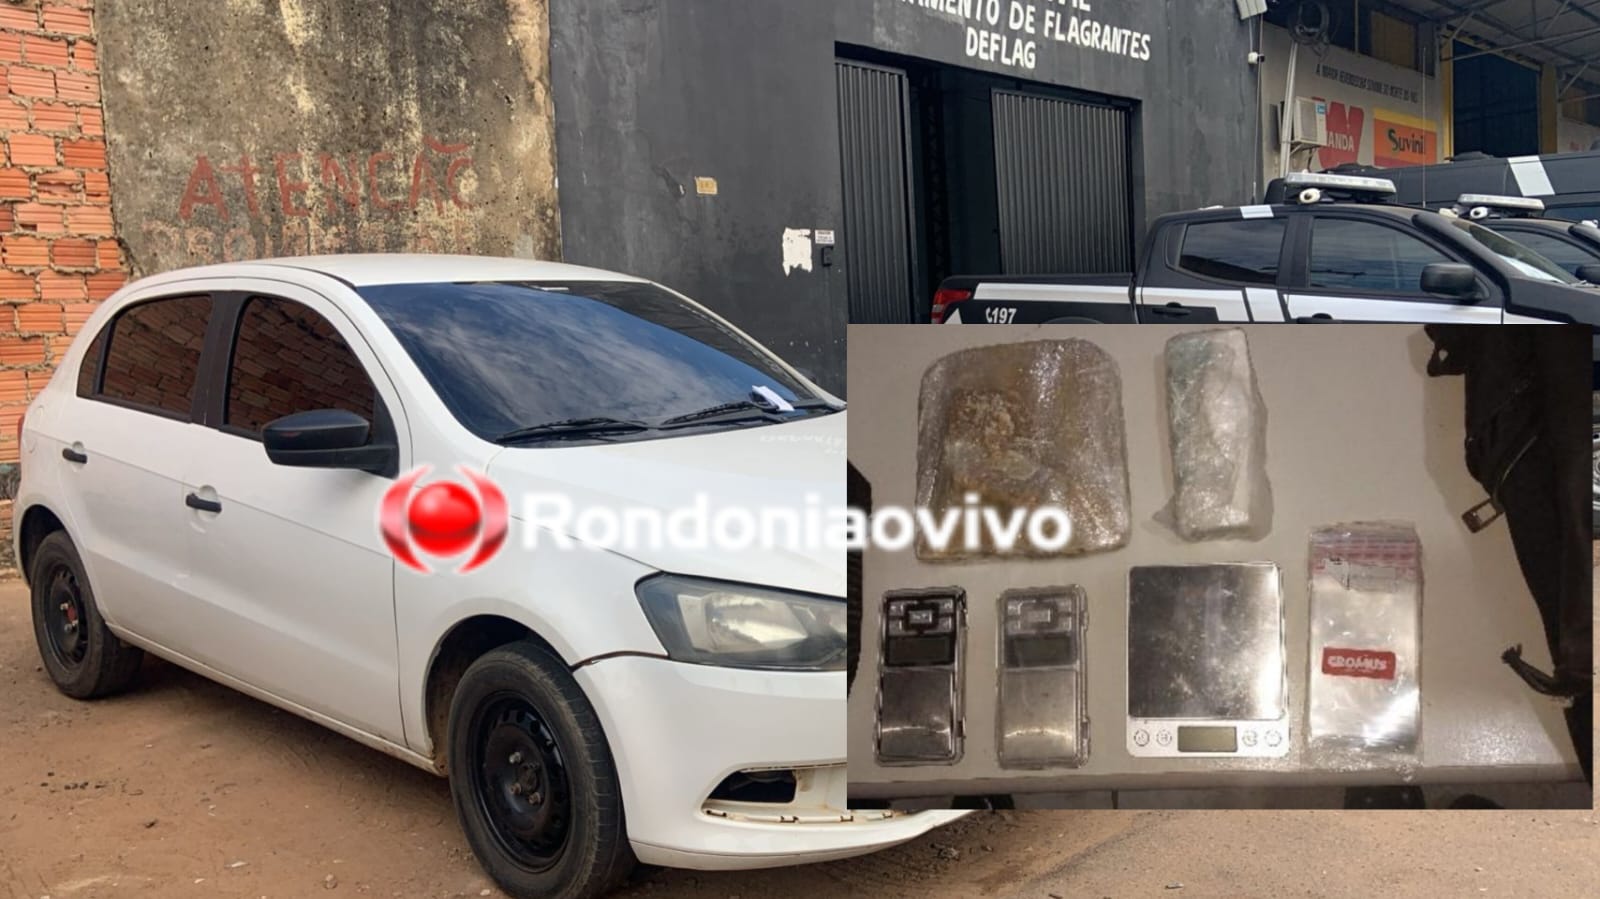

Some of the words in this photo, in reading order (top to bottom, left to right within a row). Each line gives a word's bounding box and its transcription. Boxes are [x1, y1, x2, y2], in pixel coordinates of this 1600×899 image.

[965, 26, 1036, 69] DEFLAG
[1008, 4, 1036, 34] DE
[1043, 10, 1151, 61] FLAGRANTES
[1328, 131, 1355, 152] ANDA
[991, 307, 1017, 324] 197
